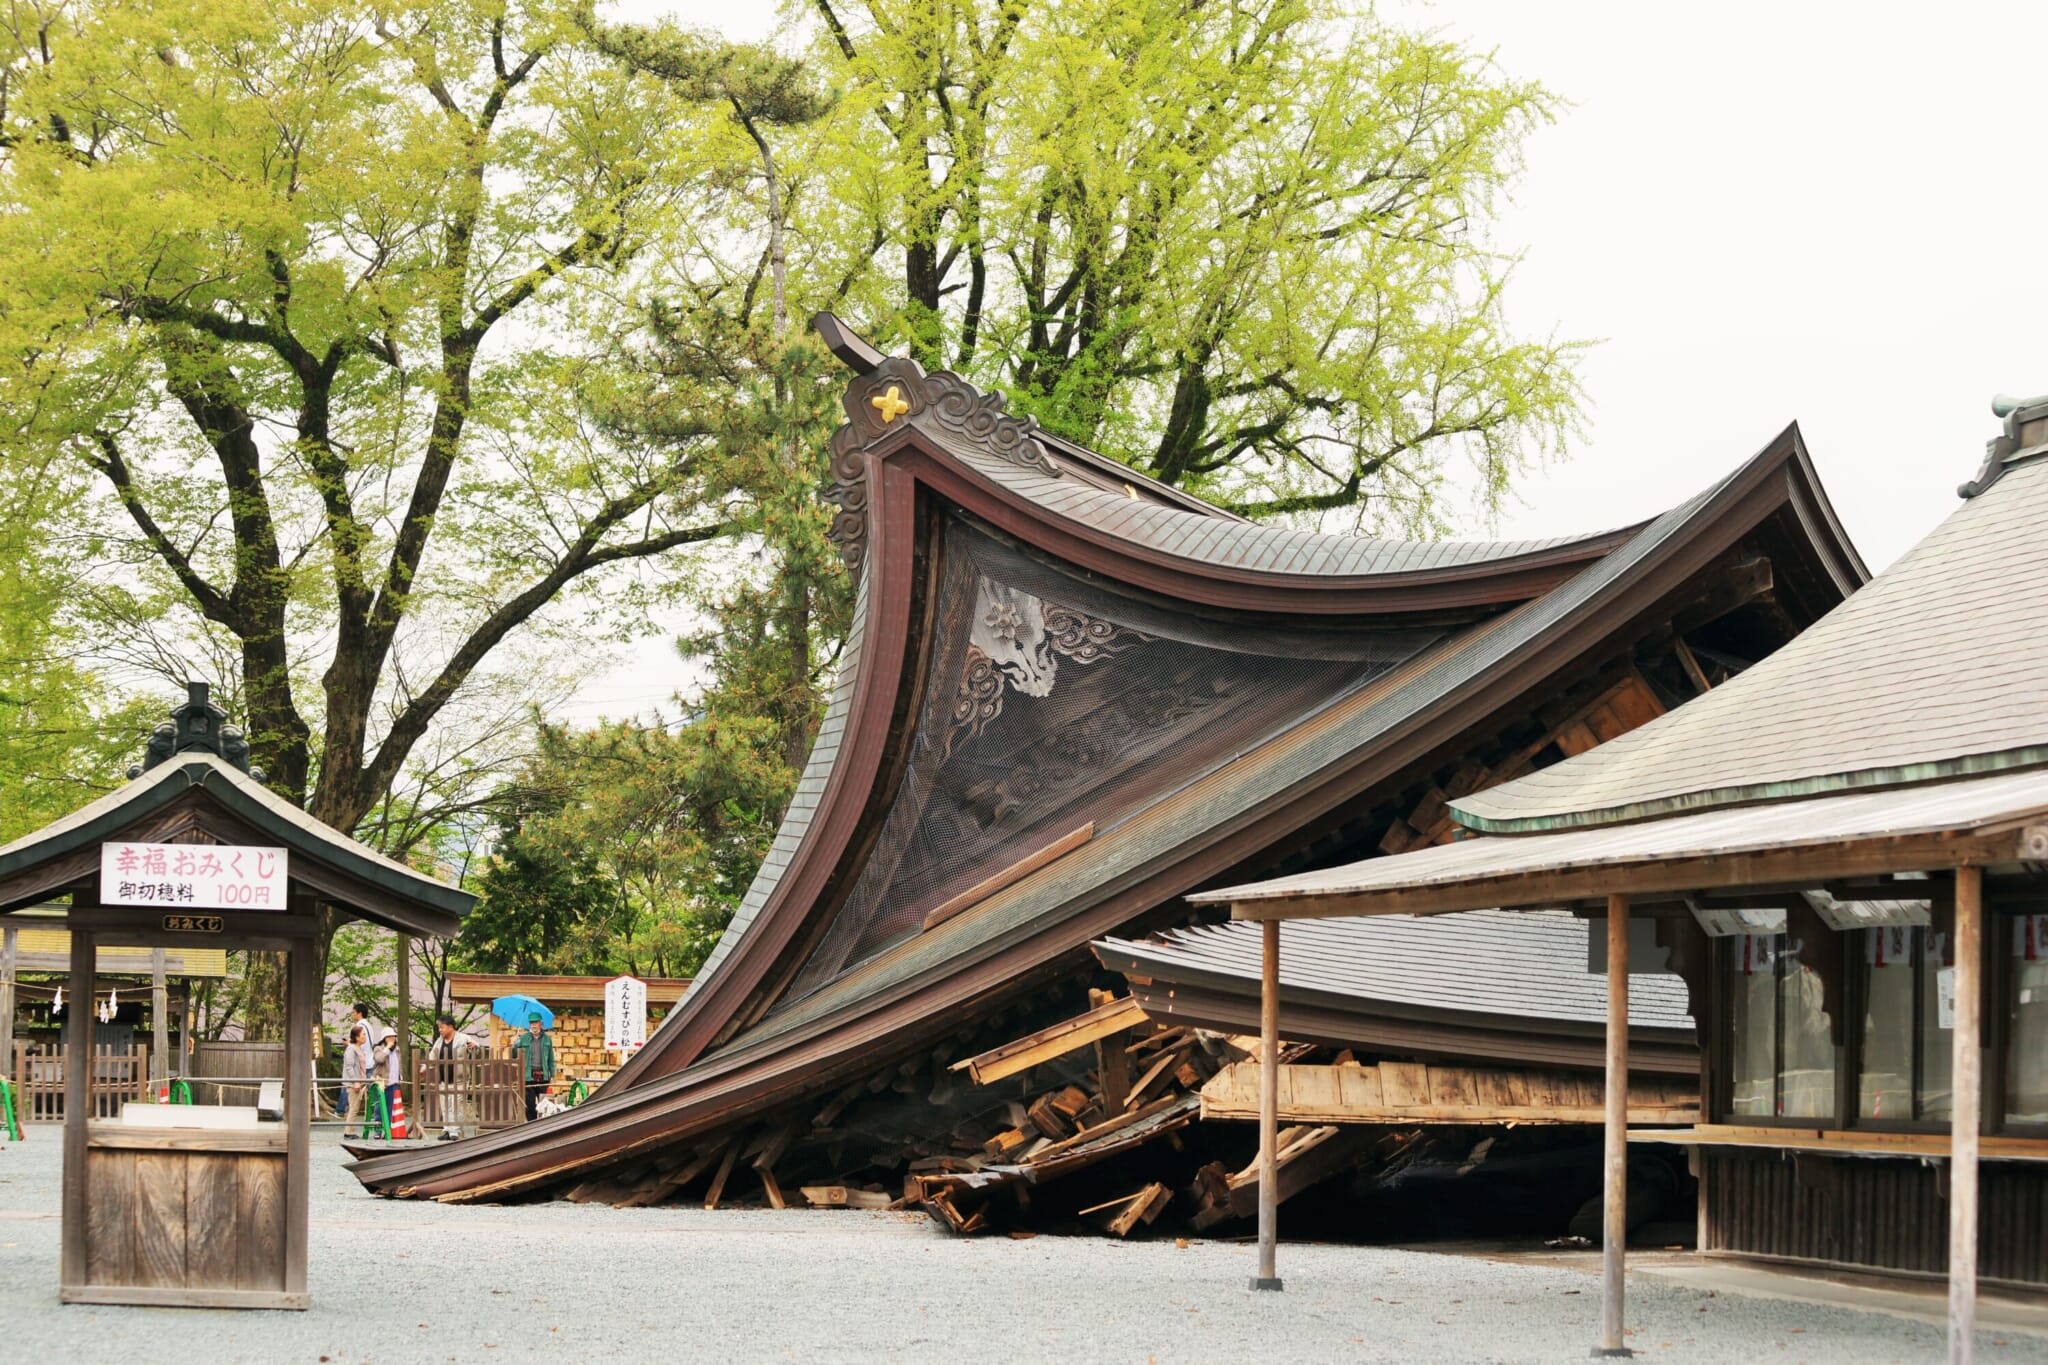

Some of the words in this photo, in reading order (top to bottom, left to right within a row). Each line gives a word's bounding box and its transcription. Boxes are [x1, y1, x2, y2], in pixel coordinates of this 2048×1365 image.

[115, 846, 276, 880] 幸福おみくじ
[118, 881, 195, 903] 御初穂料
[217, 883, 271, 905] 100円
[168, 917, 219, 931] おみくじ
[621, 981, 631, 1047] えんむすびの松
